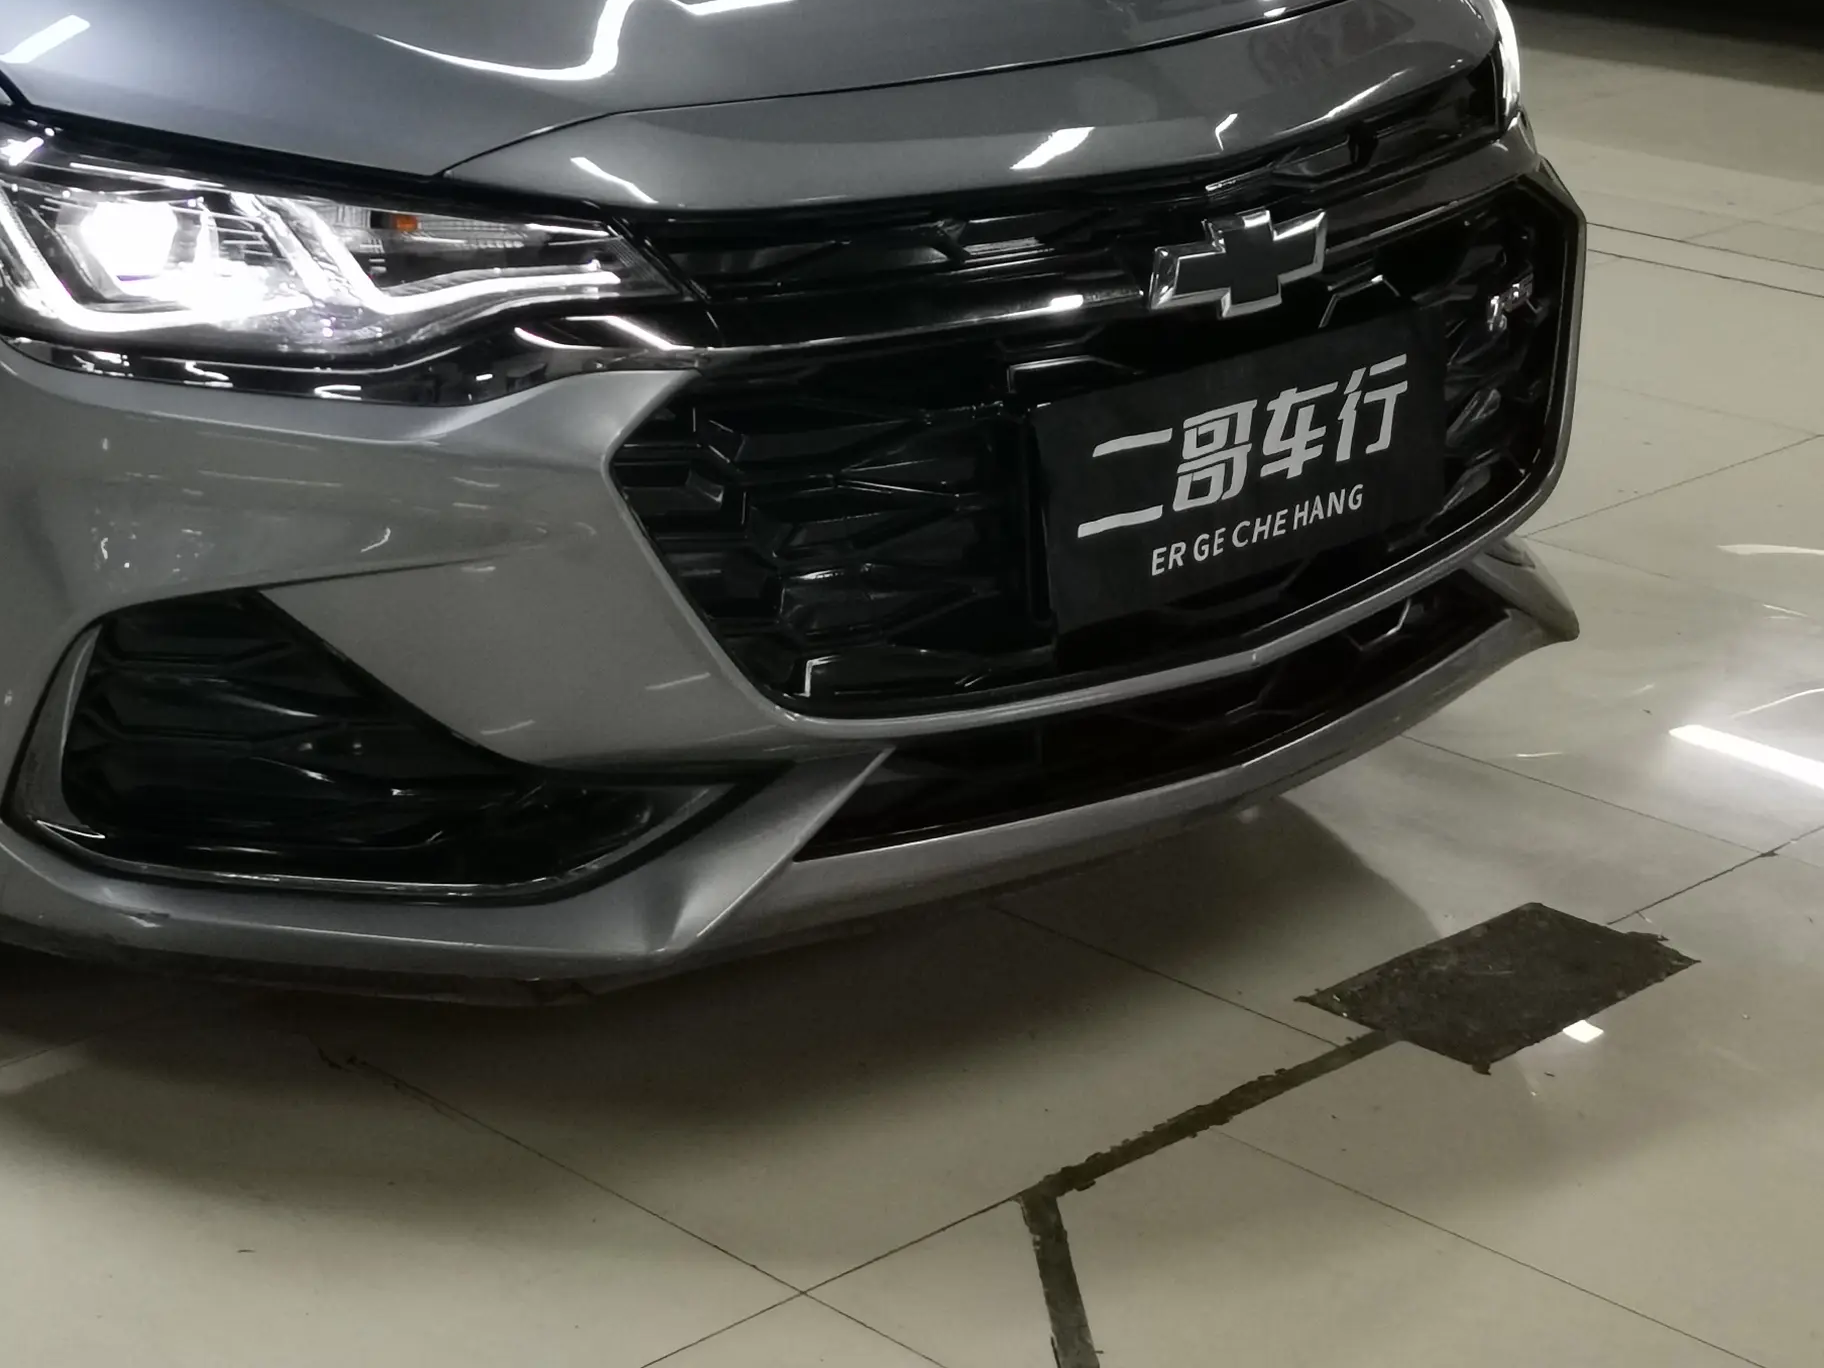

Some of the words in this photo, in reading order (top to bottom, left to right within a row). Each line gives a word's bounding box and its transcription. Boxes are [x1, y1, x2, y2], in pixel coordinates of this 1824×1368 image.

[1077, 353, 1409, 538] 二哥车行
[1151, 541, 1187, 576] ER
[1193, 527, 1227, 562] GE
[1231, 508, 1289, 548] CHE
[1293, 483, 1364, 530] HANG
